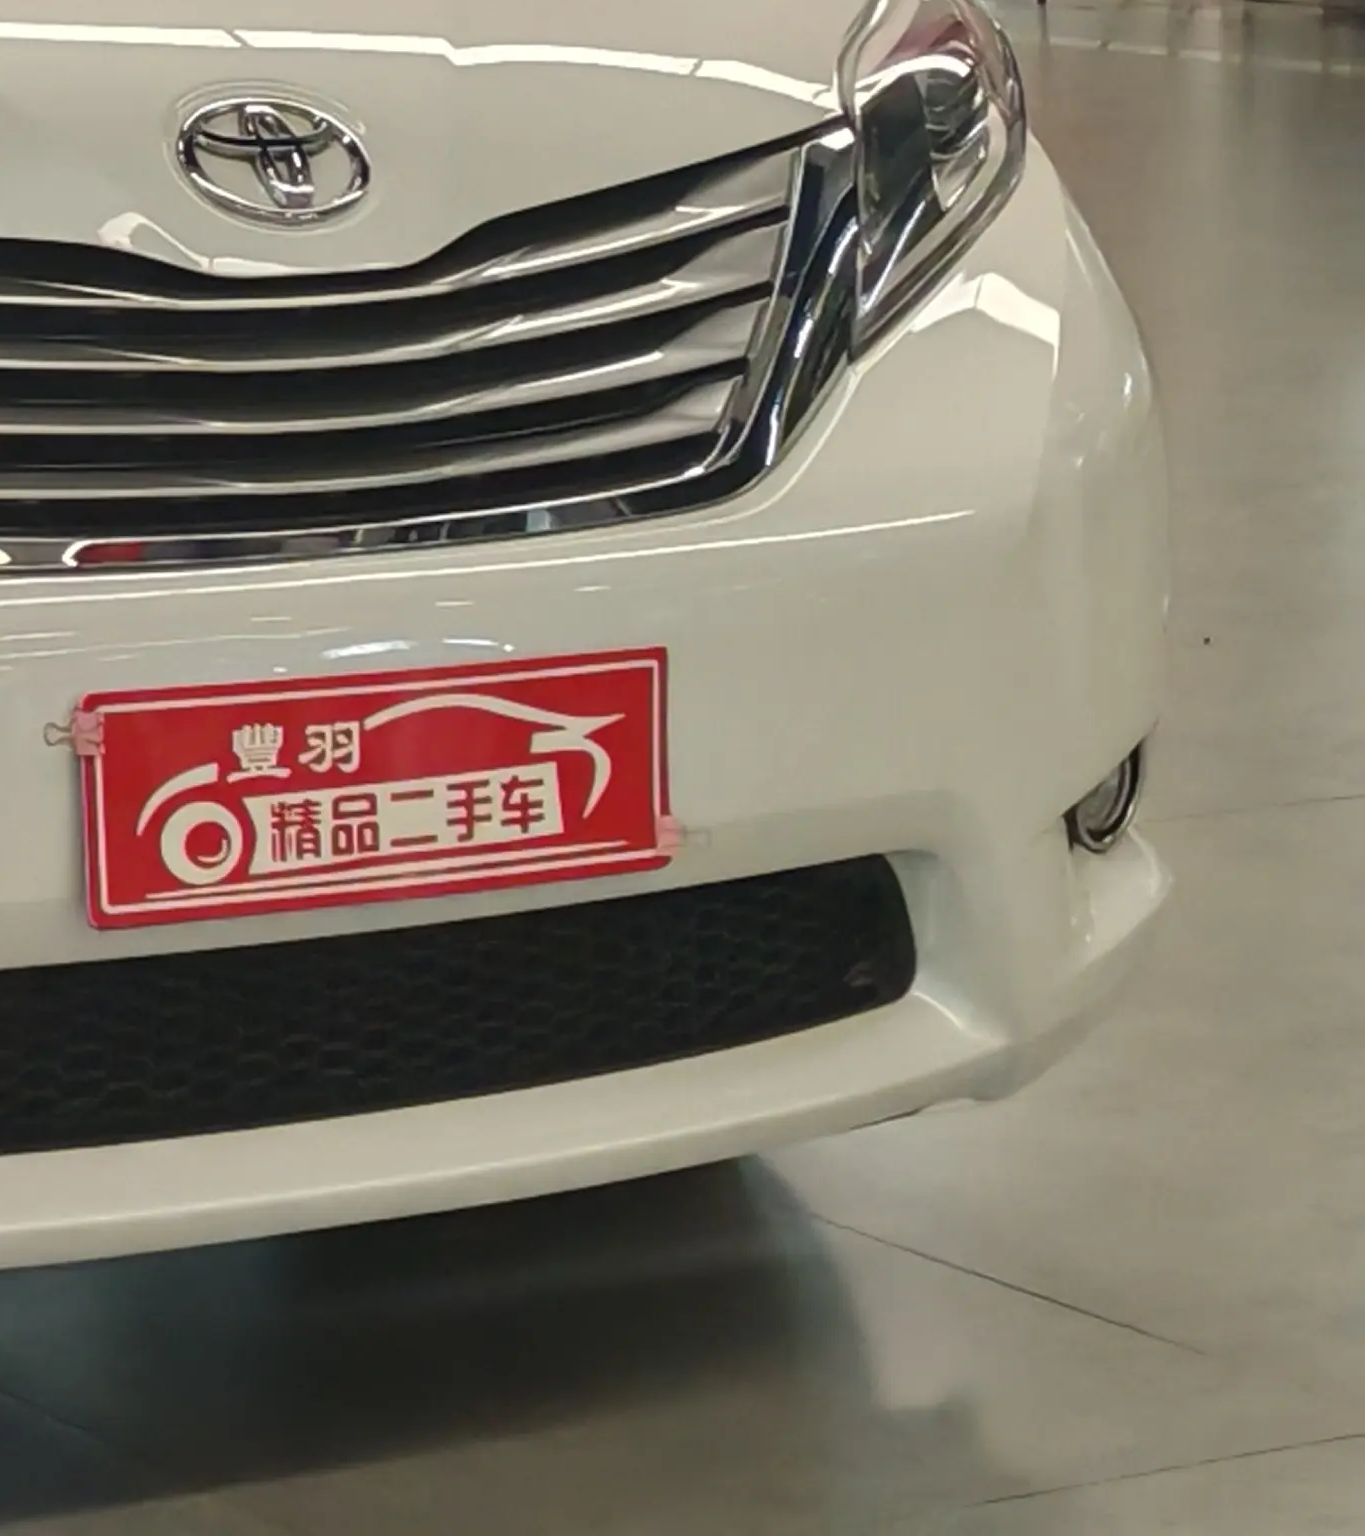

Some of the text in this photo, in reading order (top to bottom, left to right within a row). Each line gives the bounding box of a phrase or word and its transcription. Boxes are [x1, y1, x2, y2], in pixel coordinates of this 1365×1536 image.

[269, 774, 548, 865] 精品二手车
